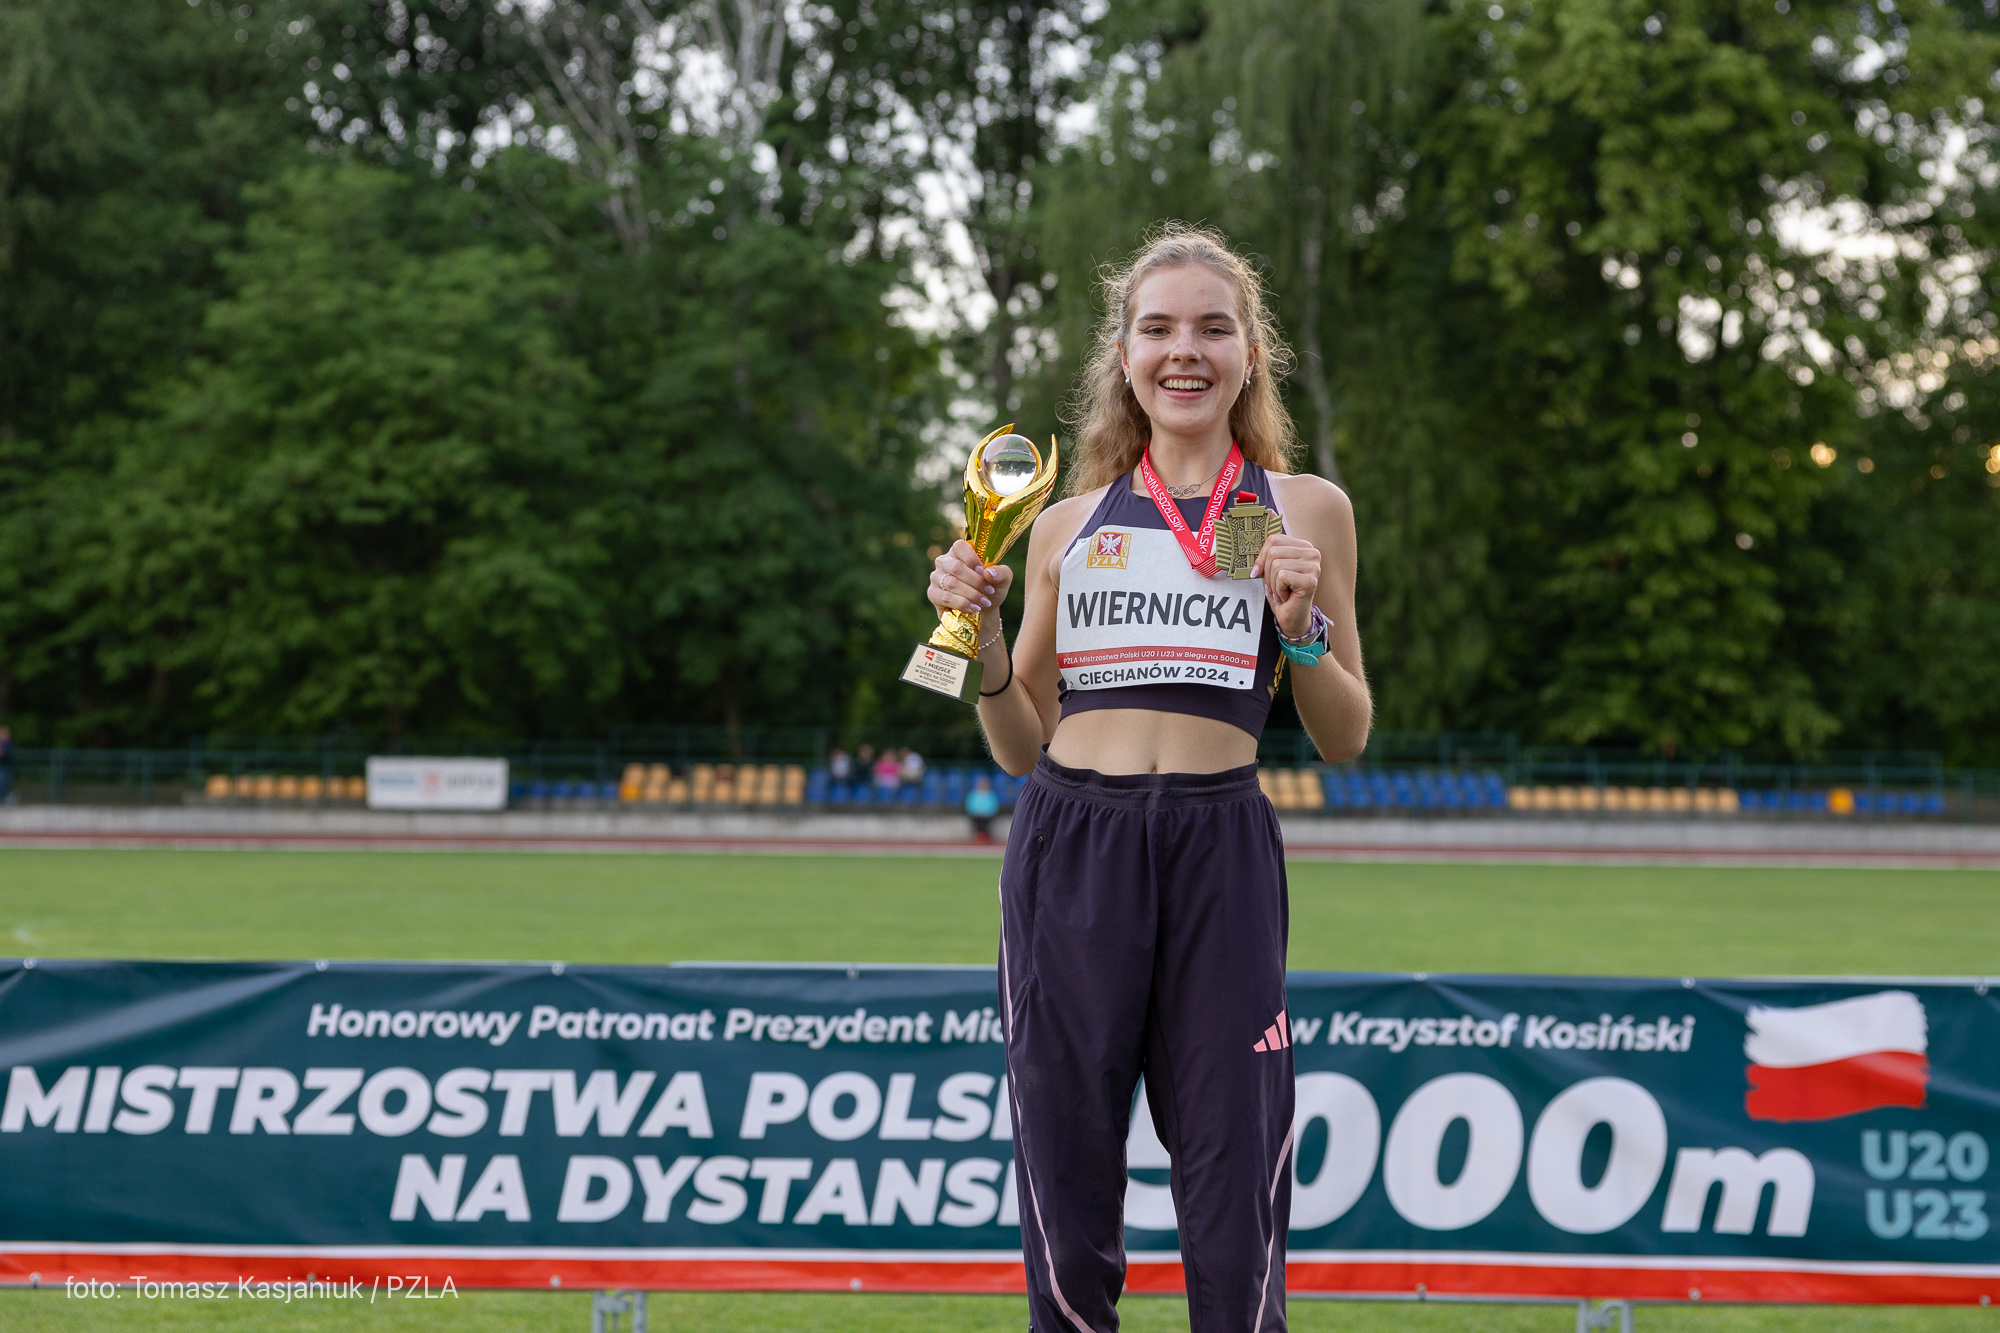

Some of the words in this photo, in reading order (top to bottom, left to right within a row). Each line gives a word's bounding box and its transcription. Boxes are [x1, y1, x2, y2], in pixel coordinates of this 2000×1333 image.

[1207, 462, 1237, 518] MISTRZOSTWA
[1089, 557, 1125, 568] PZLA
[1067, 591, 1252, 634] WIERNICKA
[1064, 656, 1078, 664] PZLA
[1080, 653, 1118, 663] Mistrzostwa
[1120, 651, 1140, 659] Polski
[1184, 652, 1206, 660] Biegu
[1220, 655, 1240, 664] 5000
[1078, 662, 1182, 685] CIECHANÓW
[1184, 666, 1230, 682] 2024
[307, 1002, 520, 1045] Honorowy
[528, 1006, 713, 1042] Patronat
[723, 1008, 932, 1050] Prezydent
[1328, 1010, 1520, 1052] Krzysztof
[1525, 1013, 1695, 1051] Kosiński
[1, 1066, 714, 1138] MISTRZOSTWA
[1861, 1130, 1988, 1182] U20
[390, 1154, 532, 1222] NA
[1865, 1190, 1989, 1240] U23
